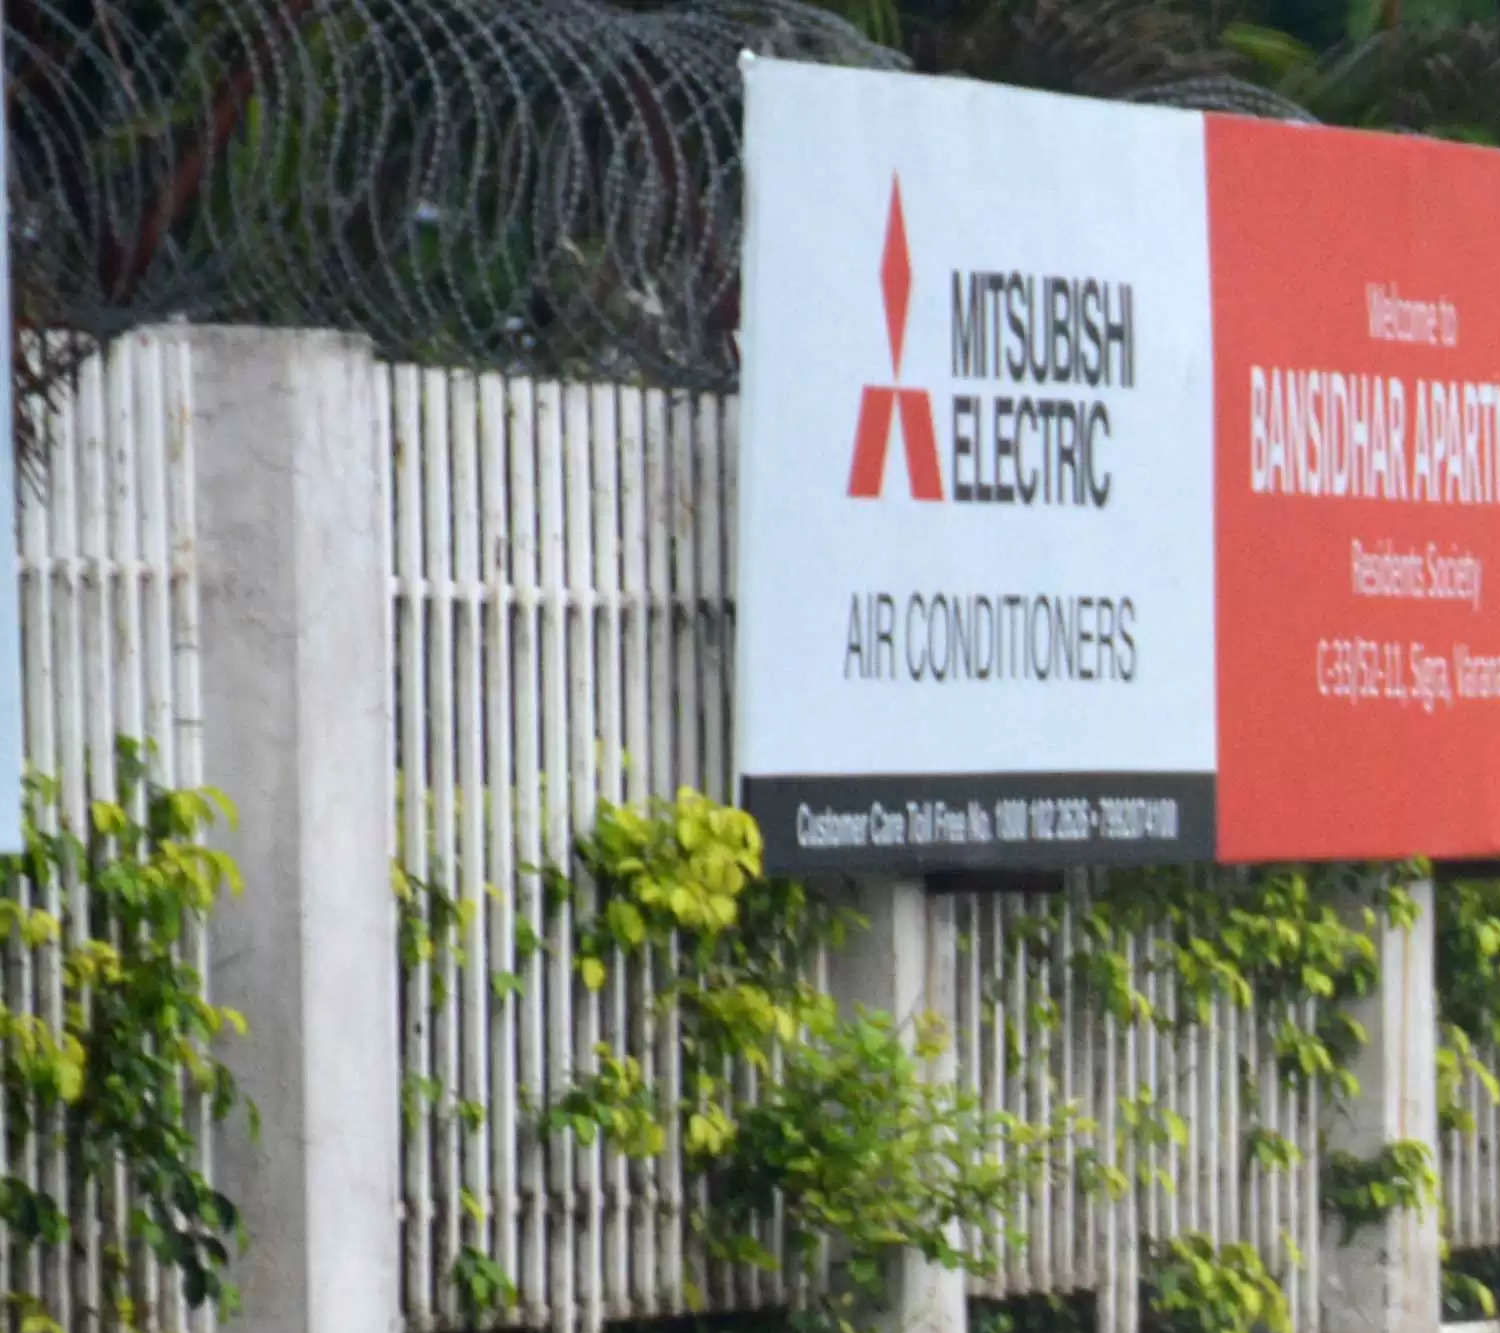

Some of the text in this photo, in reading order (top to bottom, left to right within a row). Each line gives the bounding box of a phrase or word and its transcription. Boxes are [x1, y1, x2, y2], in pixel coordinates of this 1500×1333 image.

[952, 270, 1134, 388] MITSUBISHI
[952, 395, 1113, 509] ELECTRIC
[1250, 365, 1408, 500] BANSIDHAR
[844, 590, 1137, 682] AIR CONDITIONERS
